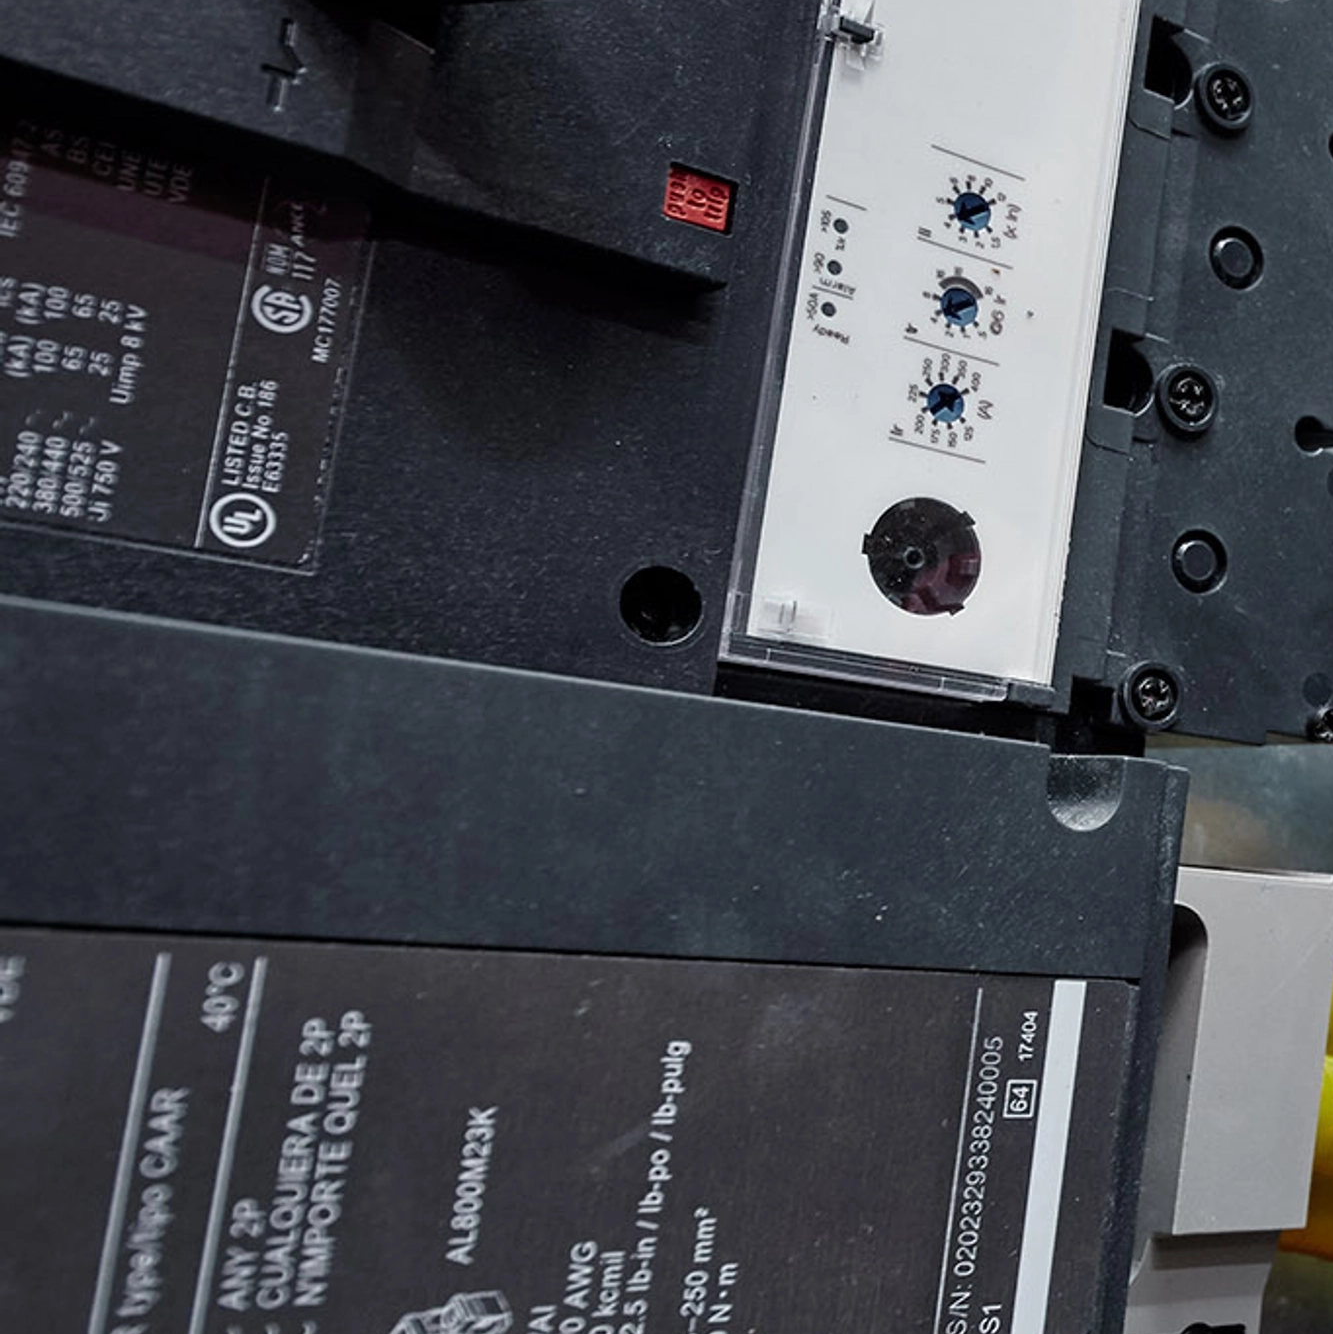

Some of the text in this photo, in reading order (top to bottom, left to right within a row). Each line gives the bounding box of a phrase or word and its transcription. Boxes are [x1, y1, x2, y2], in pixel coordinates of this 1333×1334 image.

[43, 285, 70, 319] 100
[71, 293, 97, 318] 65
[97, 299, 123, 325] 25
[123, 303, 148, 333] kV
[32, 338, 61, 373] 100
[60, 345, 87, 372] 65
[87, 351, 113, 377] 25
[109, 353, 143, 405] Uimp
[99, 439, 123, 457] V
[221, 419, 251, 487] LISTED
[240, 442, 268, 490] Issue
[256, 379, 280, 409] 186
[91, 459, 120, 495] 750
[299, 1016, 336, 1058] 2P
[337, 1009, 373, 1050] 2P
[1017, 1010, 1039, 1062] 17404
[289, 1061, 332, 1106] DE
[322, 1054, 368, 1136] QUEL
[650, 1039, 693, 1126] lb-pulg
[1009, 1086, 1030, 1113] 64
[138, 1086, 190, 1180] CAAR
[445, 1105, 499, 1267] AL800M23K
[636, 1148, 673, 1214] lb-po
[228, 1197, 267, 1239] 2P
[255, 1110, 324, 1310] CUALQUIERA
[216, 1244, 259, 1312] ANY
[563, 1239, 599, 1311] AWG
[591, 1249, 627, 1319] kcmil
[629, 1235, 659, 1294] lb-in
